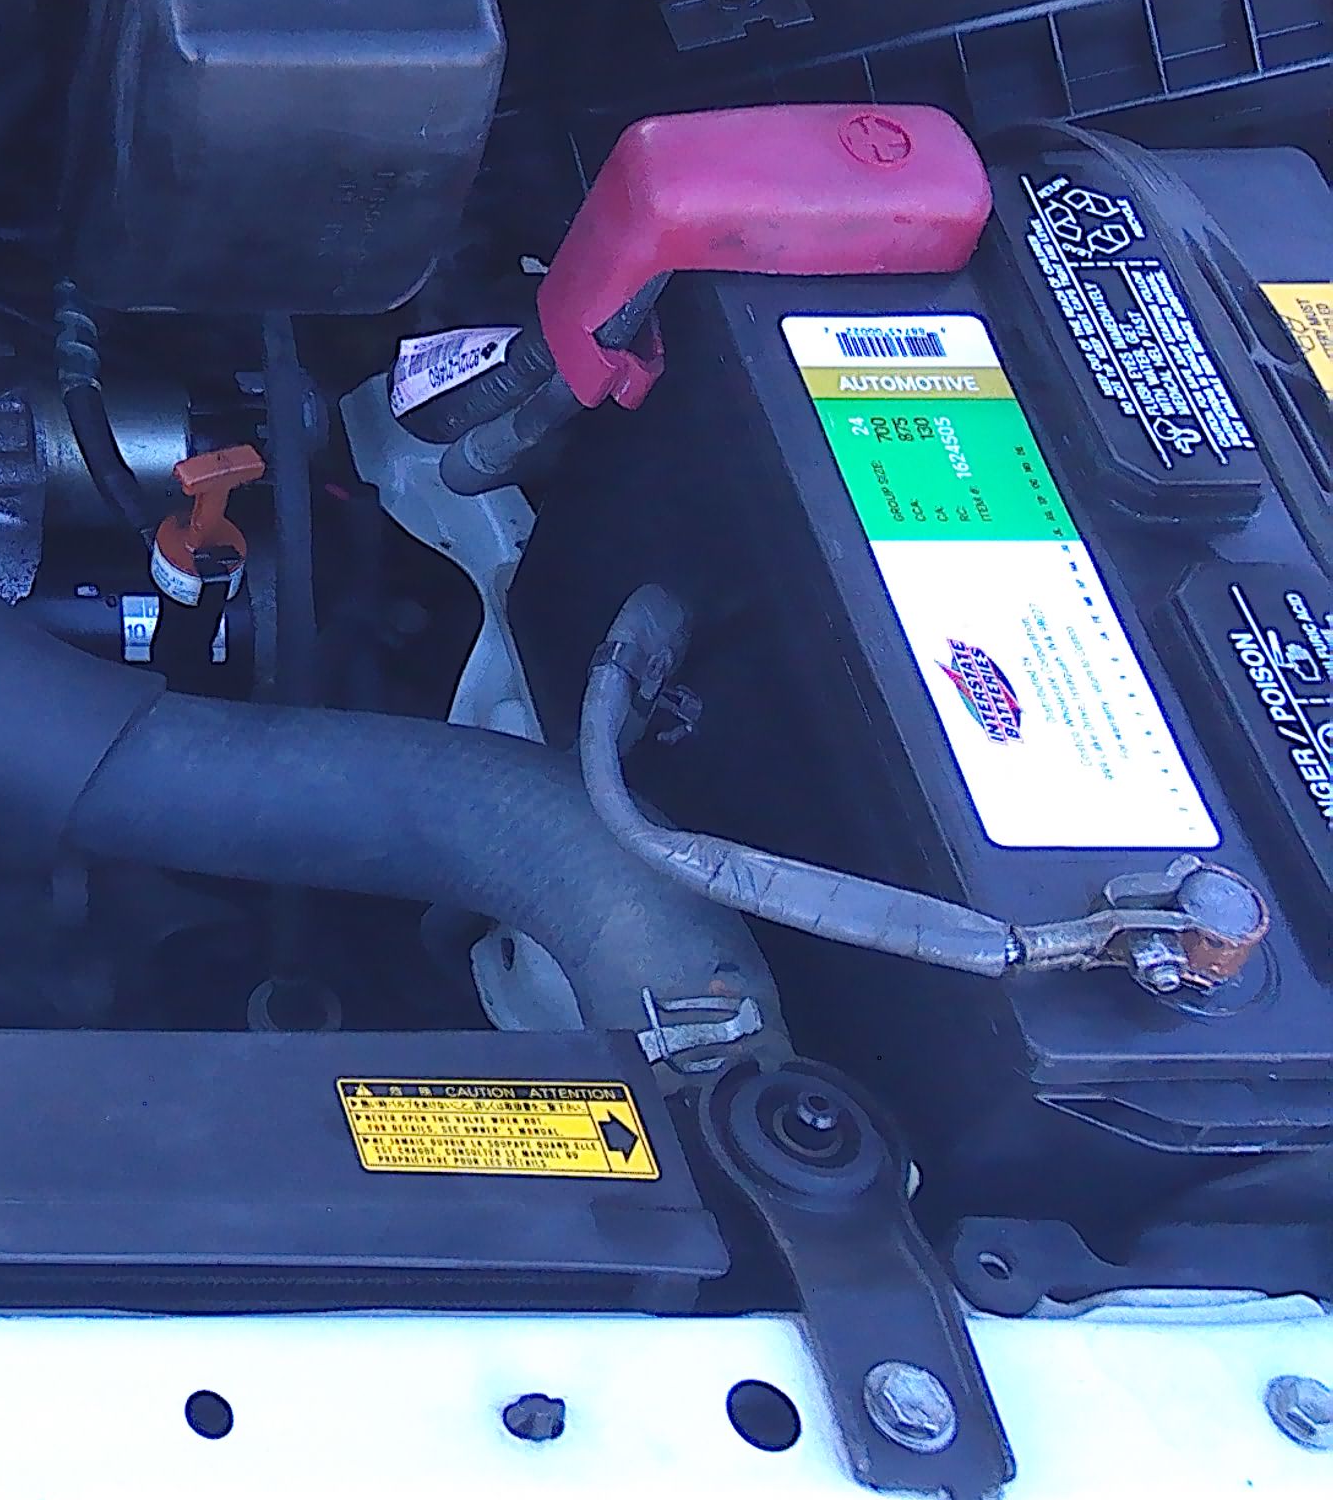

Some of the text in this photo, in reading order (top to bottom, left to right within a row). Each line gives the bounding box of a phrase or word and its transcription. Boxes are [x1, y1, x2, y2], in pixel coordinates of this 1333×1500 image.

[1295, 298, 1321, 326] MUST
[1080, 281, 1163, 417] FLUSH EYES IMMEDIATELY
[1125, 309, 1194, 417] MEDICAL HELP FAST
[839, 375, 980, 392] AUTOMOTIVE
[1116, 322, 1178, 417] WITH GET
[846, 417, 870, 435] 24
[868, 417, 894, 442] 700
[890, 417, 915, 441] 875
[911, 417, 936, 439] 130
[937, 416, 974, 478] 1624505
[880, 486, 905, 521] GROUP
[1286, 593, 1314, 622] ACID
[948, 638, 1005, 742] INTERSTATE
[968, 647, 1022, 739] BATTERIES
[1231, 632, 1297, 722] POISON
[443, 1086, 516, 1098] CAUTION
[526, 1087, 616, 1099] ATTENTION
